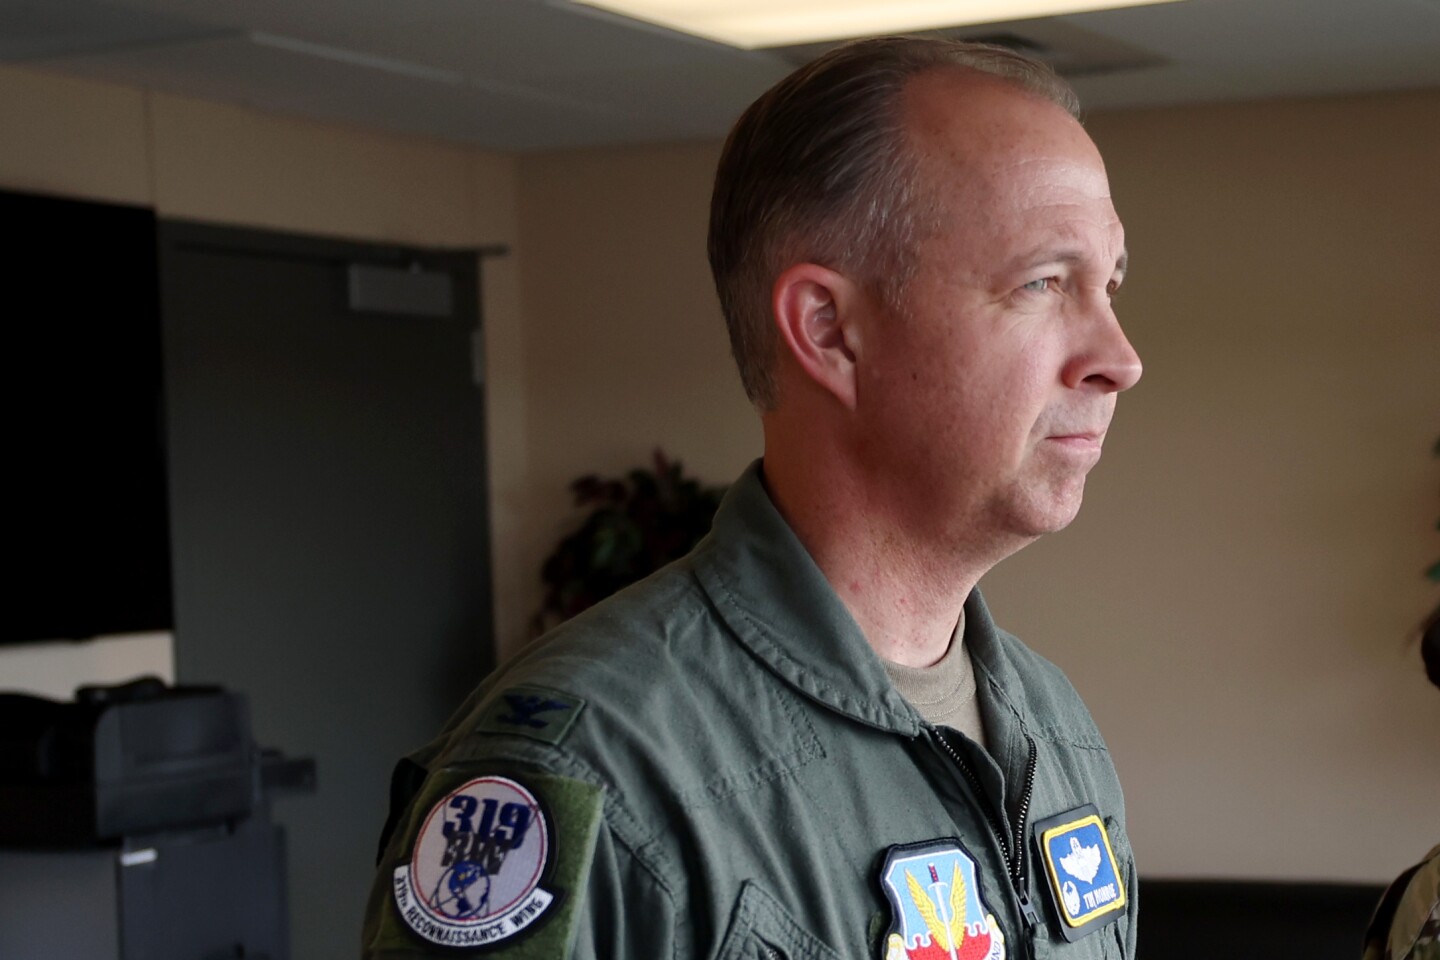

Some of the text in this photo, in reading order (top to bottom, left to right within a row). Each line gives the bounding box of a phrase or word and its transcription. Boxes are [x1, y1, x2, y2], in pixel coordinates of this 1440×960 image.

[443, 795, 531, 849] 319
[406, 905, 507, 943] RECONNAISSANCE
[510, 899, 545, 928] WING
